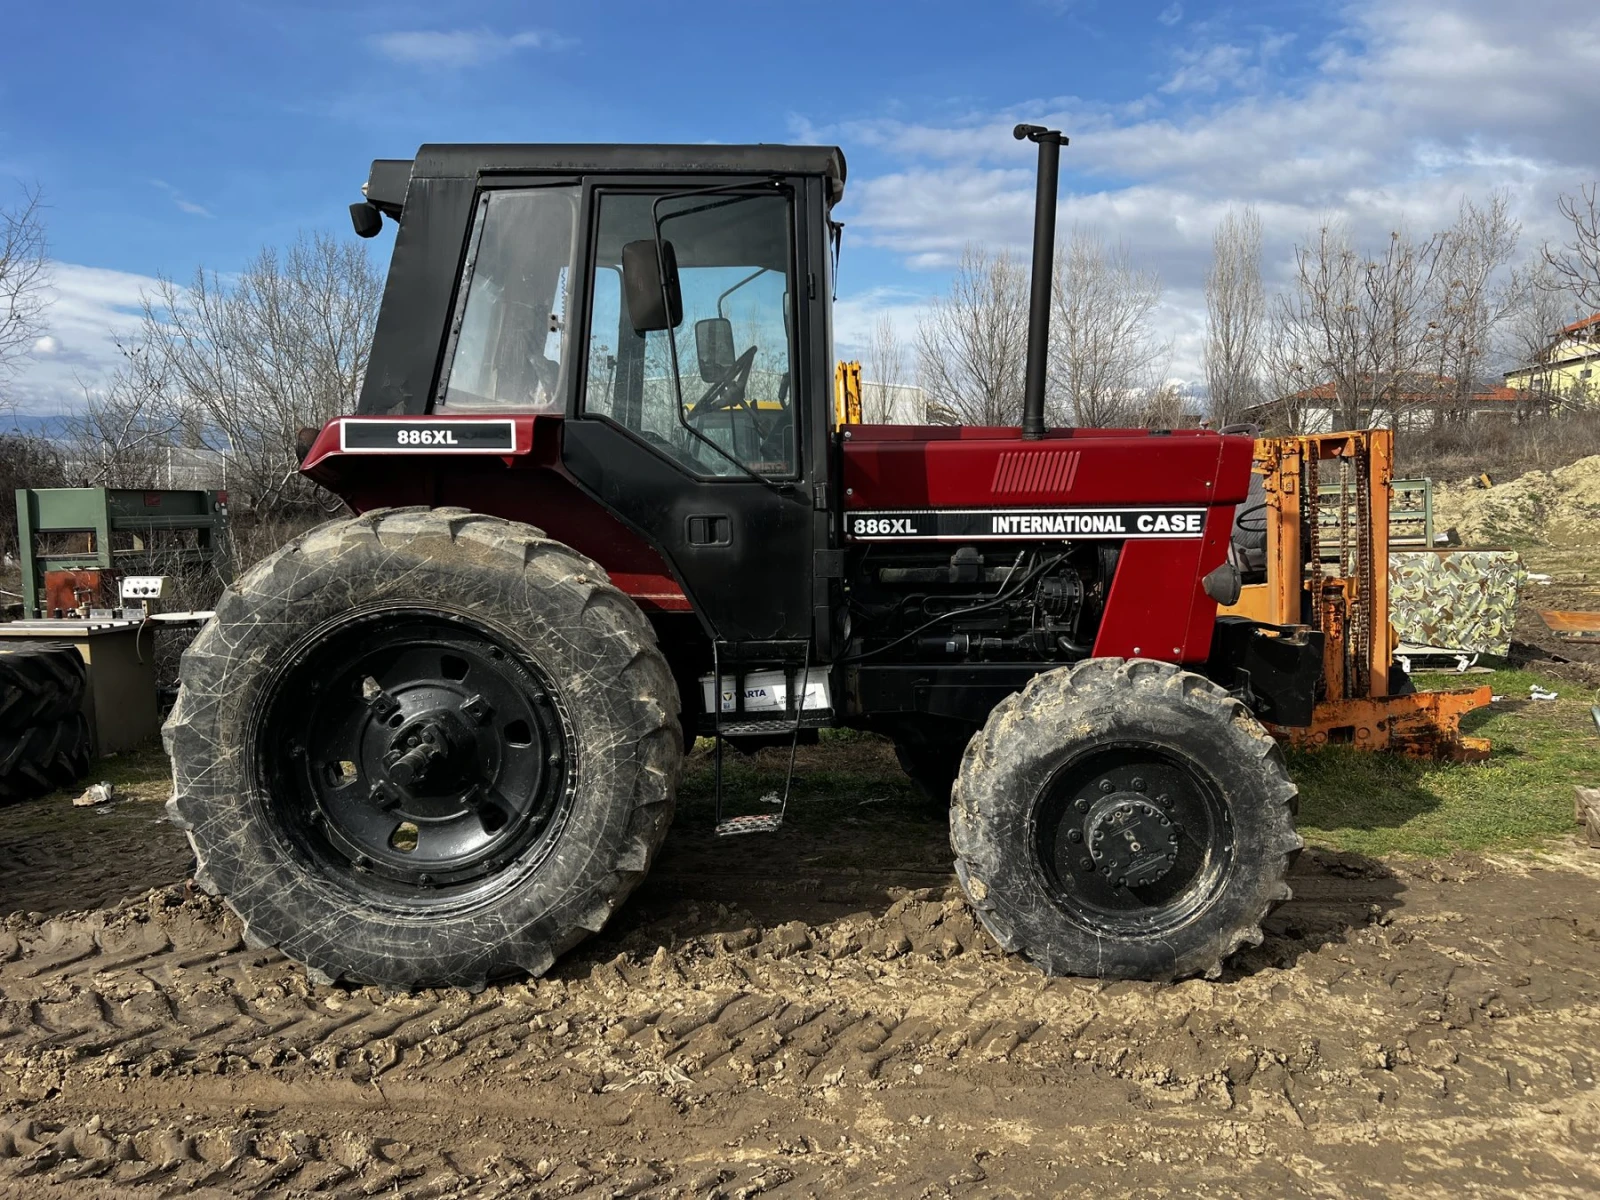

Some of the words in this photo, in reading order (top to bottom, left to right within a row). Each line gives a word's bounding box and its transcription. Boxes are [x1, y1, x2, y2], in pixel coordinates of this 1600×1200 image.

[397, 430, 458, 444] 886XL
[854, 519, 917, 534] 886XL
[993, 516, 1125, 533] INTERNATIONAL
[1137, 515, 1200, 532] CASE
